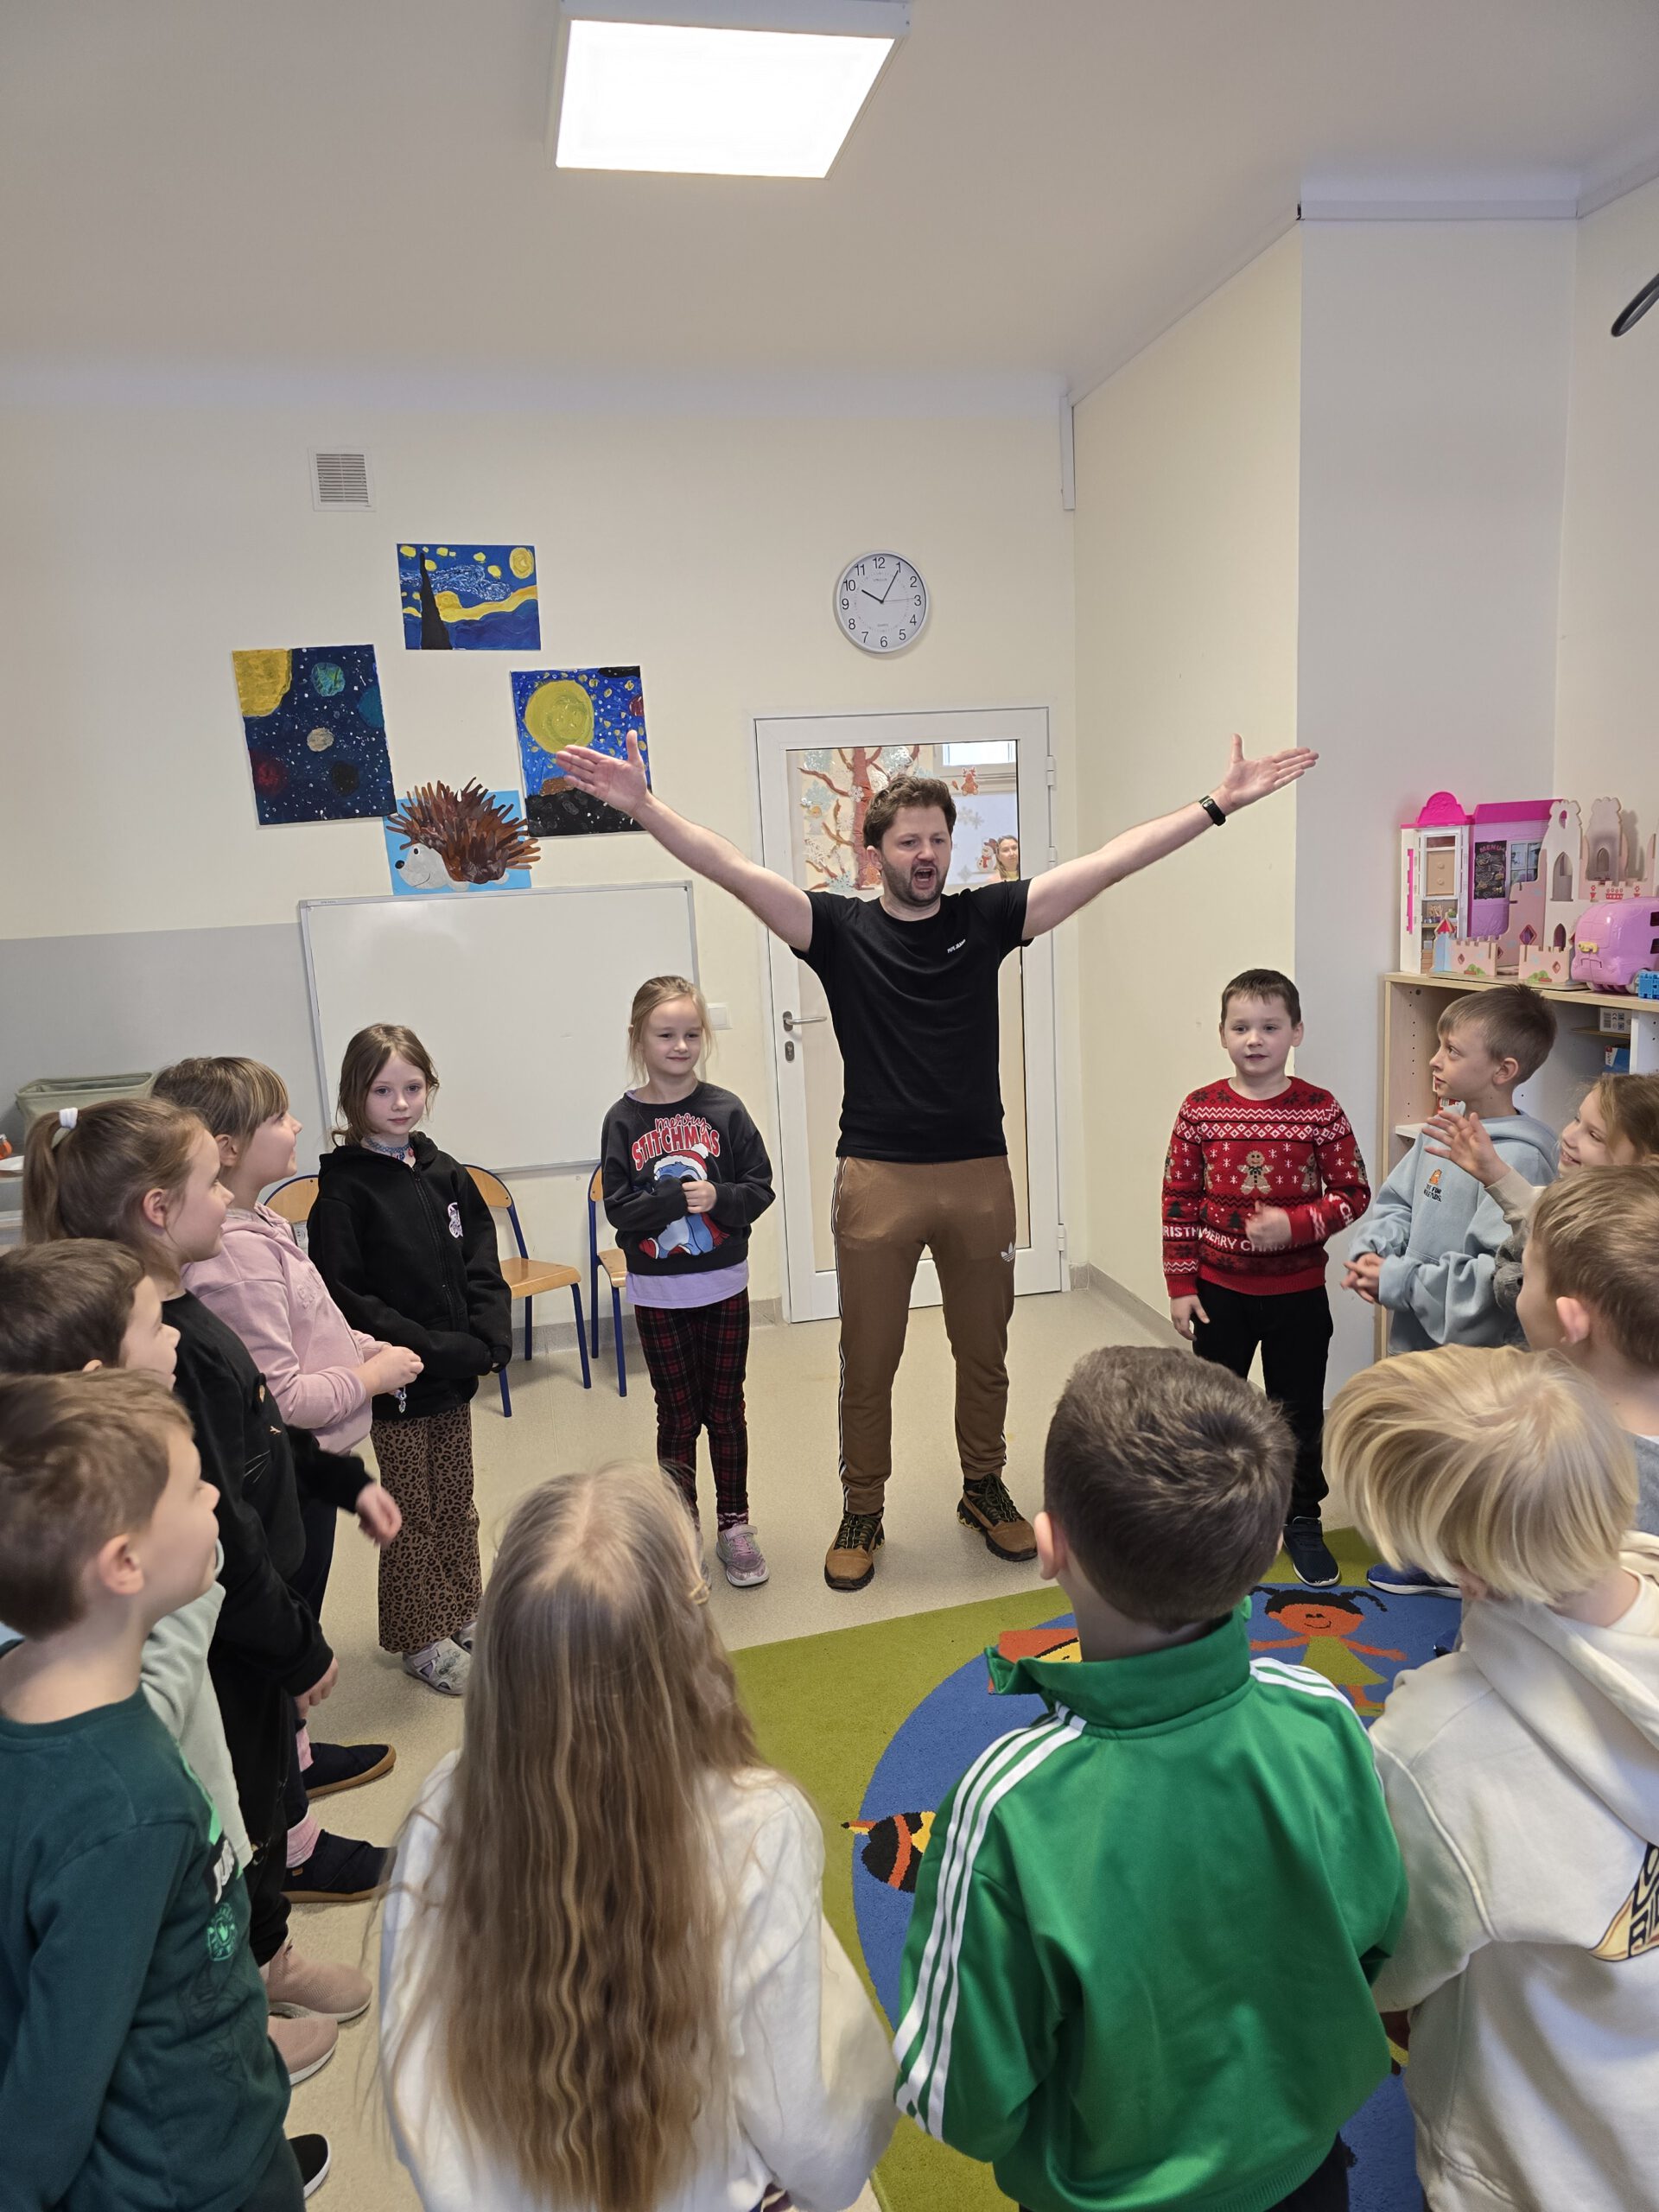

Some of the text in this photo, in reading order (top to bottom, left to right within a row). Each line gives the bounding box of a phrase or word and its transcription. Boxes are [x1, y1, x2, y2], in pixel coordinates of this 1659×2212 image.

[873, 556, 886, 569] 12
[896, 562, 901, 573] 1
[855, 564, 865, 575] 11
[843, 579, 856, 591] 10
[910, 575, 918, 588] 2
[842, 598, 849, 610] 9
[914, 594, 922, 607] 3
[849, 618, 856, 630] 8
[909, 614, 917, 626] 4
[861, 631, 869, 643] 7
[899, 628, 906, 640] 5
[880, 636, 888, 647] 6
[655, 1113, 712, 1134] merry
[632, 1125, 720, 1172] STITCHMAS
[1202, 1227, 1237, 1249] MERRY
